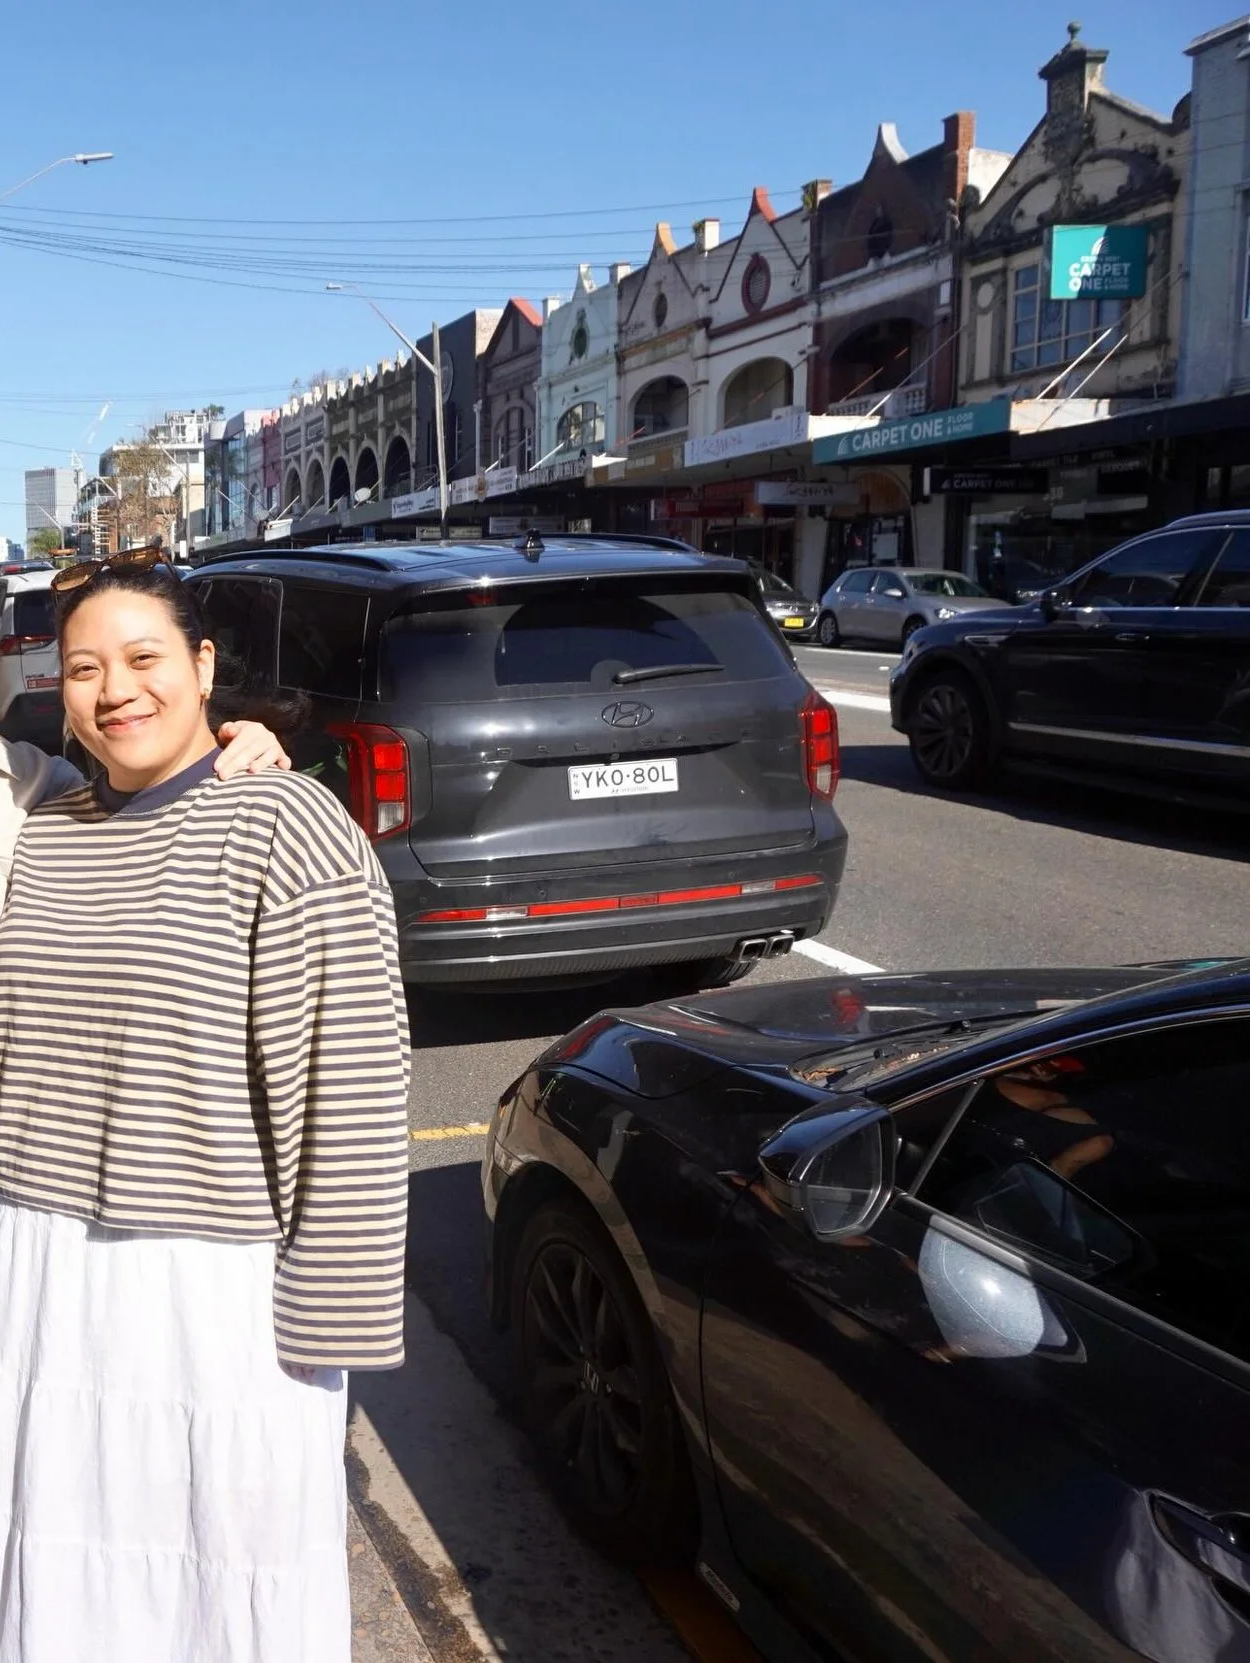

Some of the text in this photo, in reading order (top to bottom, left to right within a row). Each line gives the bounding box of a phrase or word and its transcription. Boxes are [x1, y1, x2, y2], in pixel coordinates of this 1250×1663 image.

[1069, 262, 1131, 277] CARPET
[1068, 276, 1103, 292] ONE
[852, 419, 943, 452] CARPET ONE
